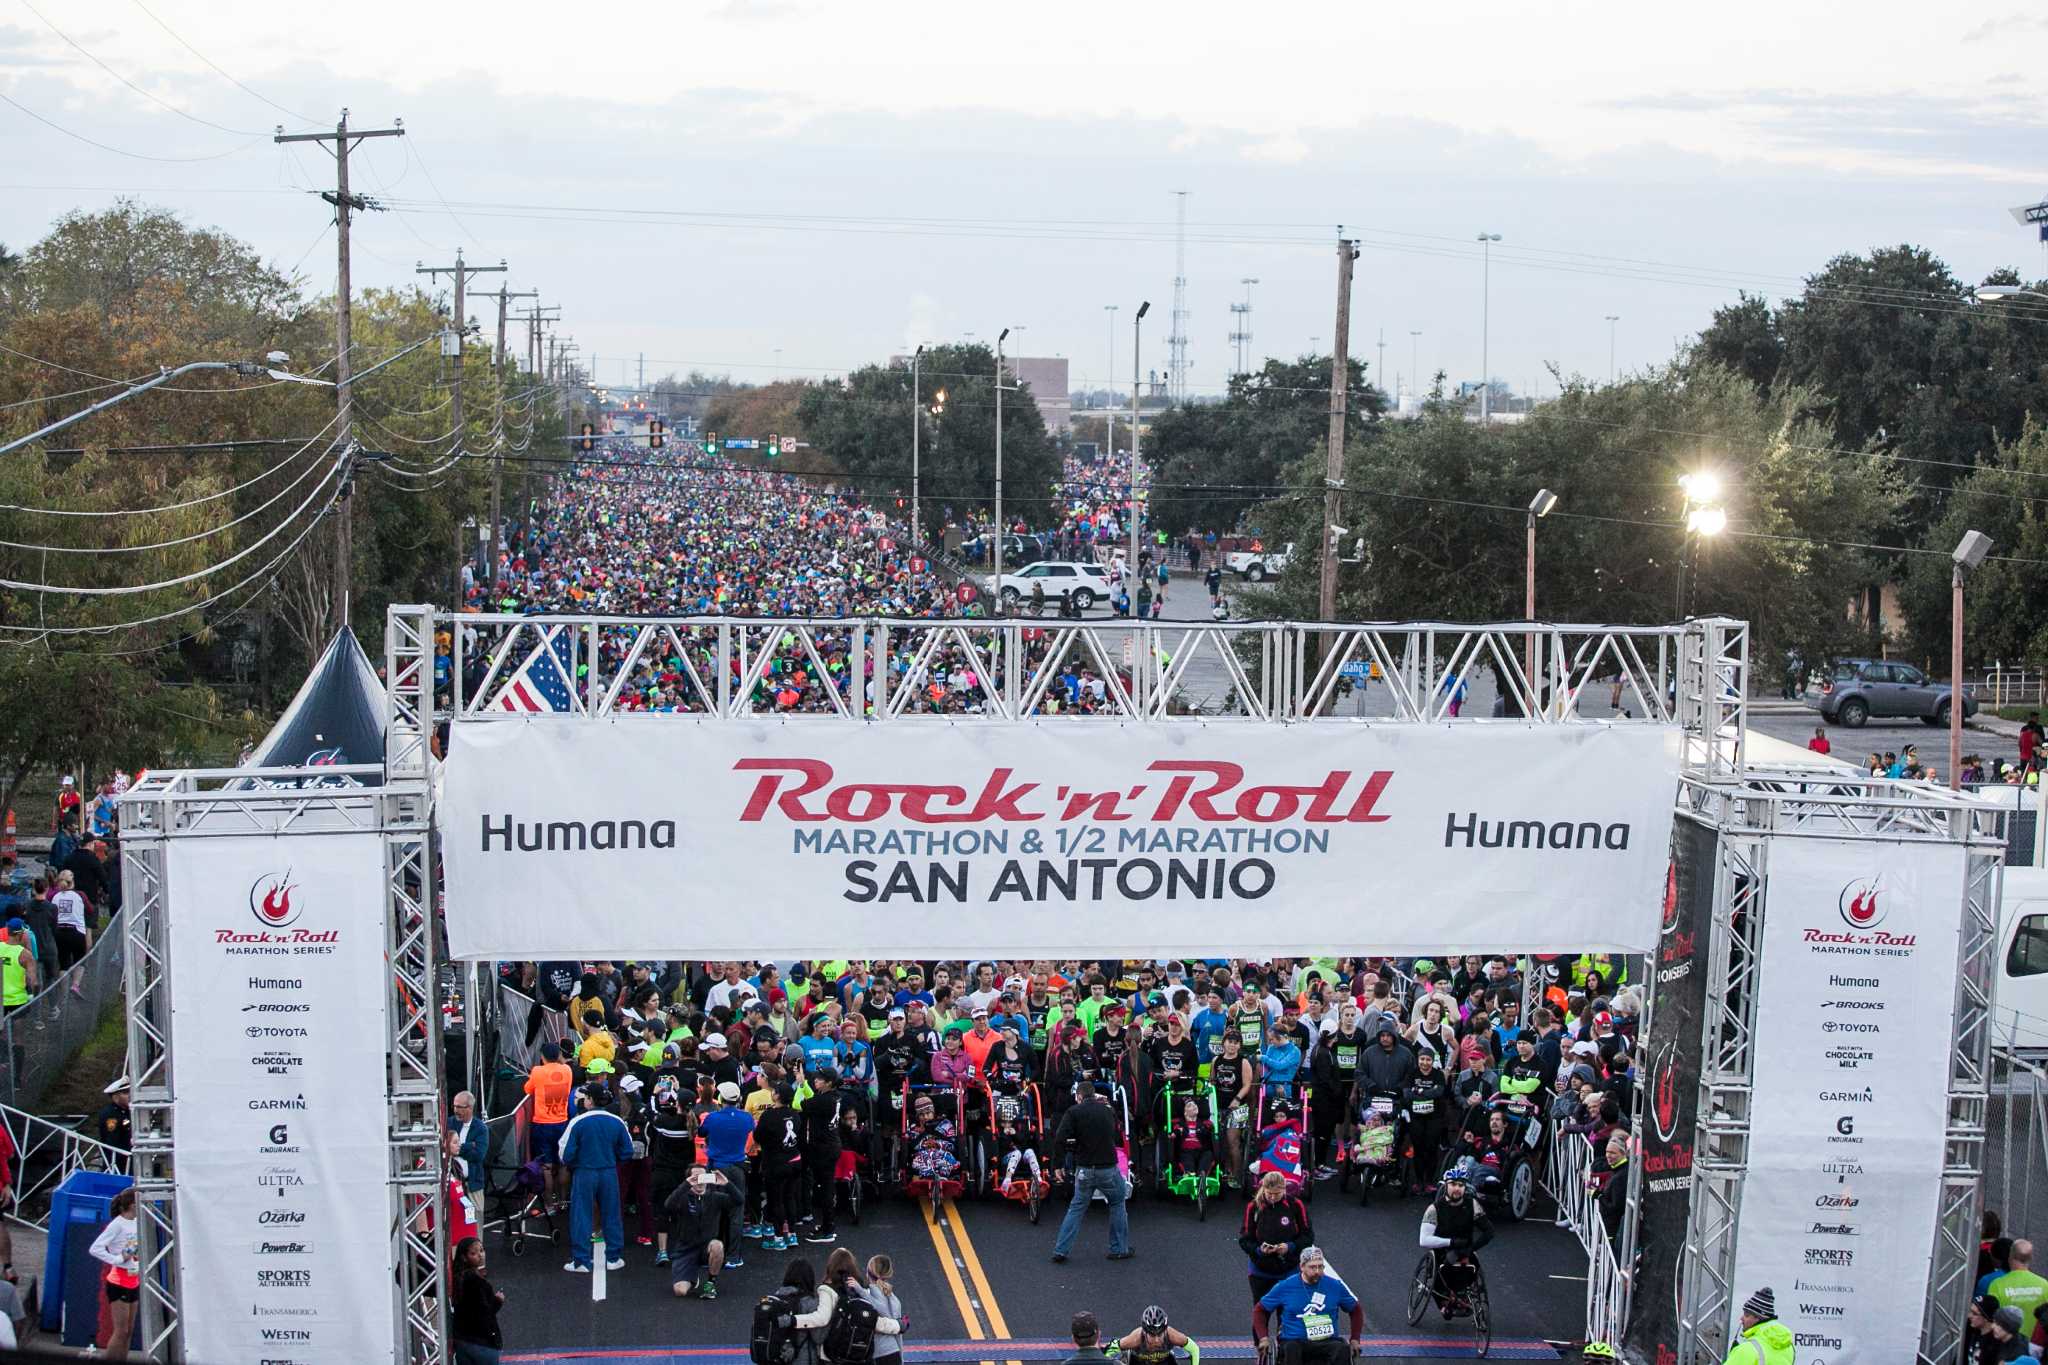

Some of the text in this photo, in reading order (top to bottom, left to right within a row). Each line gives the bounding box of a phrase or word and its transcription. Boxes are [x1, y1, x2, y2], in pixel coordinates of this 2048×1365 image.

[963, 590, 969, 600] 4
[786, 662, 793, 672] 3
[1340, 662, 1364, 673] daho
[732, 757, 1046, 823] Rock
[1146, 760, 1394, 823] Roll
[480, 814, 676, 853] Humana
[1444, 811, 1630, 851] Humana
[792, 825, 1328, 858] MARATHON & 1/2 MARATHON
[842, 858, 1275, 904] SAN ANTONIO
[215, 929, 272, 943] Rock
[291, 929, 340, 943] Roll
[1803, 928, 1855, 945] Rock
[1874, 932, 1917, 946] Roll
[226, 947, 289, 955] MARATHON
[1811, 945, 1871, 956] MARATHON
[249, 977, 302, 989] Humana
[1829, 974, 1880, 988] Humana
[258, 1003, 311, 1013] BROOKS
[1835, 1000, 1885, 1010] BROOKS
[263, 1027, 308, 1037] TOYOTA
[1839, 1022, 1880, 1033] TOYOTA
[1825, 1051, 1873, 1060] CHOCOLATE
[251, 1057, 303, 1066] CHOCOLATE
[1839, 1060, 1858, 1068] MILK
[267, 1066, 288, 1074] MILK
[1819, 1091, 1873, 1102] GARMIN
[248, 1099, 307, 1110] GARMIN
[1822, 1163, 1864, 1174] ULTRA
[258, 1175, 304, 1186] ULTRA
[1649, 1178, 1675, 1192] MARATHON
[1815, 1195, 1859, 1207] Ozarka
[258, 1210, 305, 1224] Ozarka
[1812, 1222, 1855, 1234] PowerBar
[261, 1242, 306, 1253] PowerBar
[1804, 1249, 1854, 1260] SPORTS
[1803, 1259, 1852, 1267] AUTHORITY
[257, 1270, 311, 1281] SPORTS
[1799, 1303, 1844, 1315] WESTIN
[261, 1328, 310, 1340] WESTIN
[1308, 1325, 1332, 1336] 20522
[1794, 1333, 1842, 1350] Running
